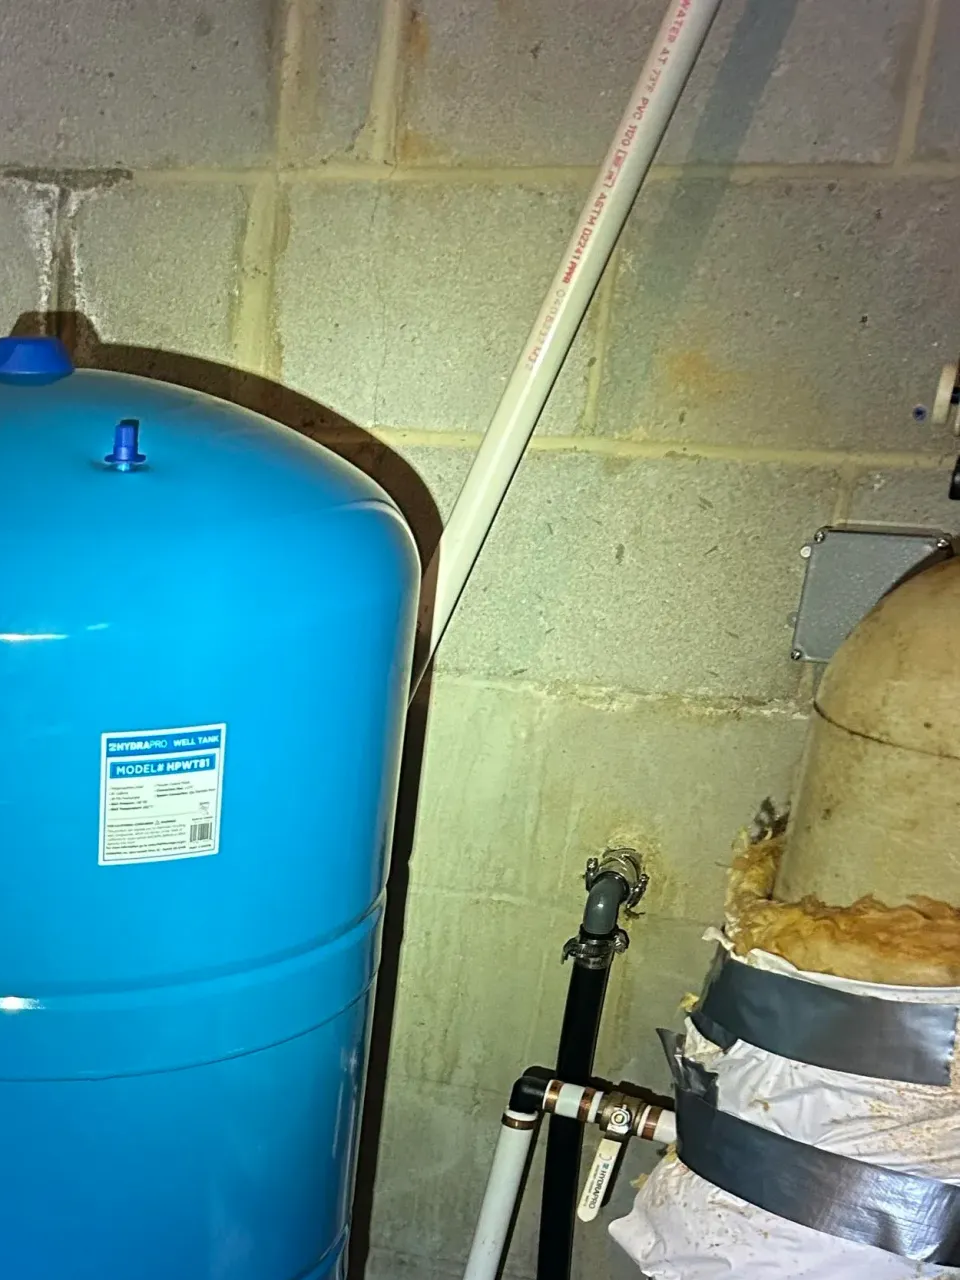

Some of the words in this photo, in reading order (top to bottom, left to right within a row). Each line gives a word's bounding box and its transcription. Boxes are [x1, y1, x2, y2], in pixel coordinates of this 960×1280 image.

[632, 96, 650, 121] PVC
[590, 191, 607, 226] ASTM
[573, 227, 592, 262] D2241
[173, 737, 196, 747] WELL
[198, 735, 220, 745] TANK
[116, 763, 165, 776] MODEL#
[166, 758, 210, 771] HPWT81
[589, 1170, 607, 1210] HYDRAPRO
